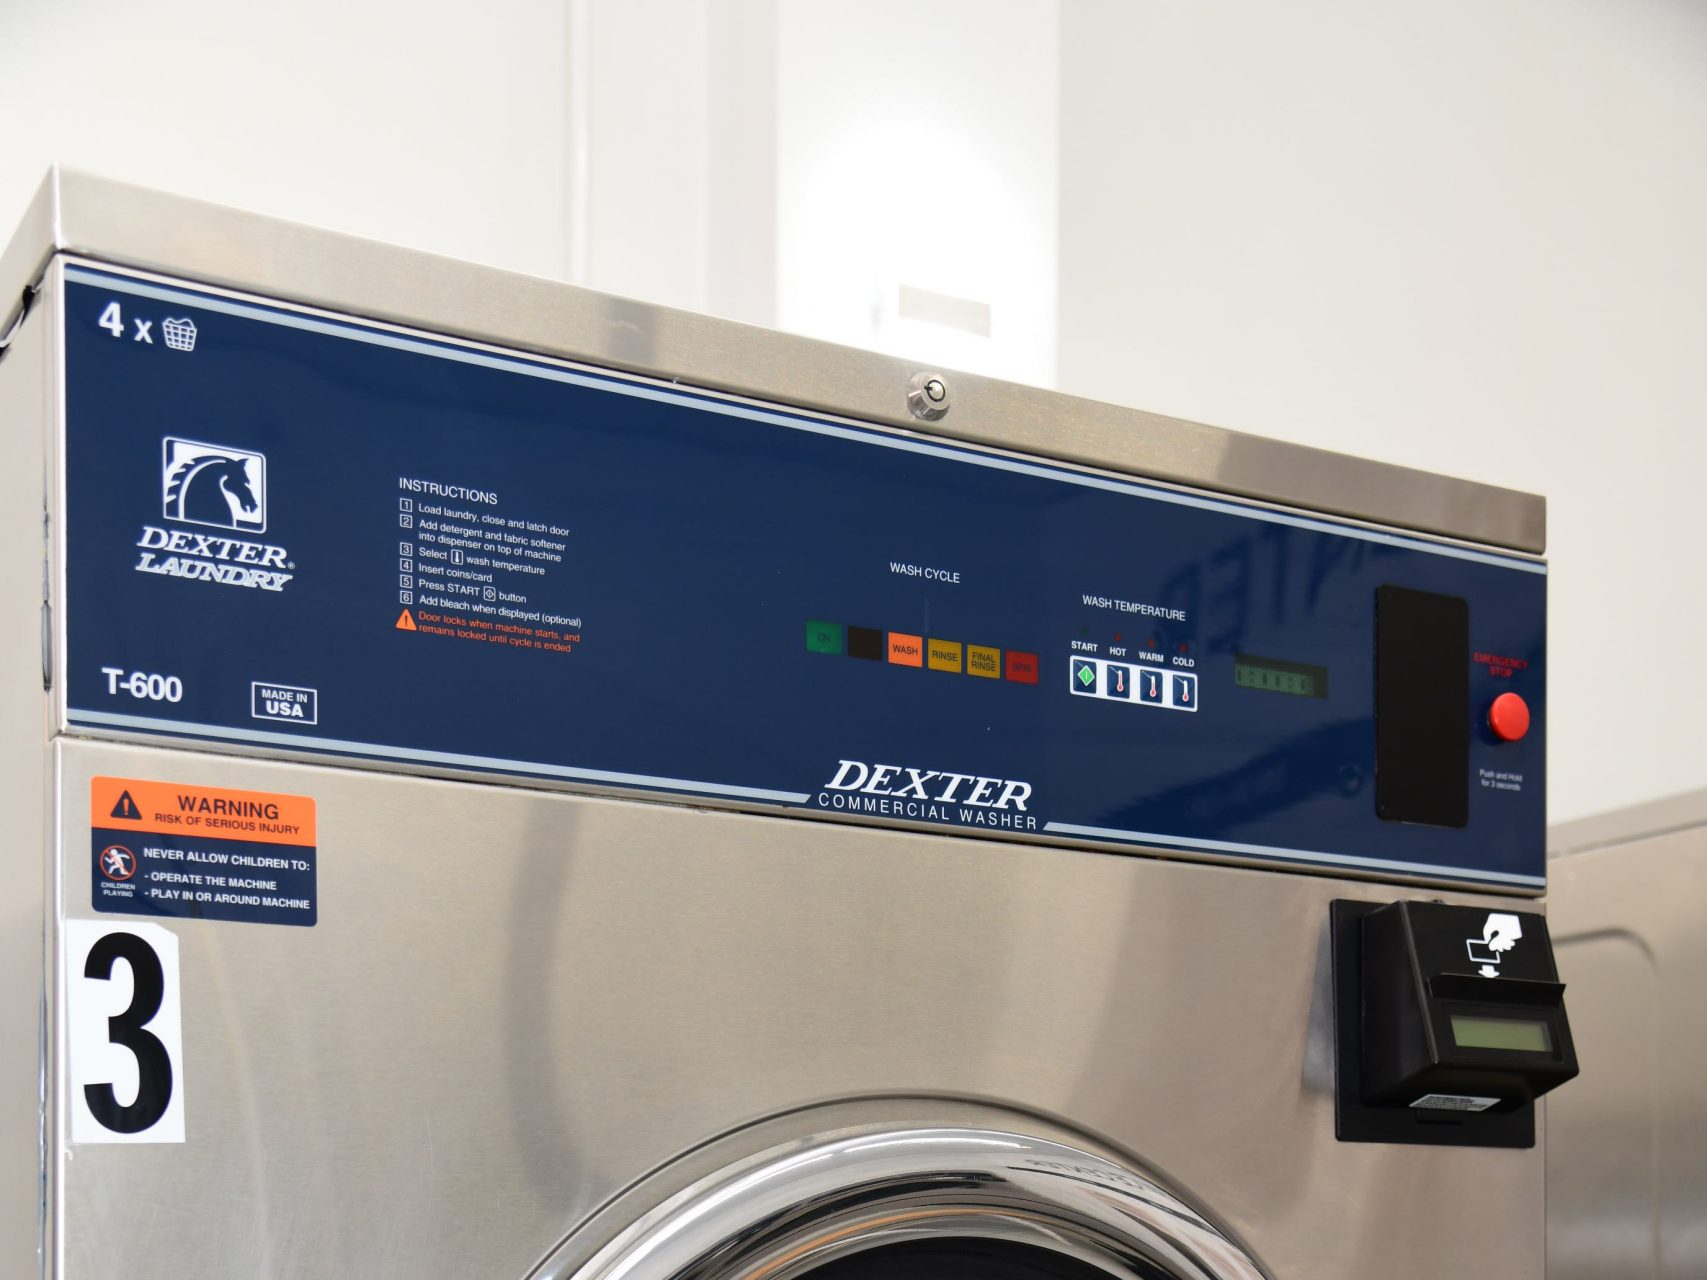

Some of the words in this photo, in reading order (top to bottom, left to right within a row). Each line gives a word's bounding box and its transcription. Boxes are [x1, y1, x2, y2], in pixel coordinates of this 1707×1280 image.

[98, 302, 124, 337] 4
[400, 477, 498, 505] INSTRUCTIONS
[419, 503, 441, 514] Load
[482, 515, 505, 525] close
[508, 520, 524, 529] and
[527, 522, 547, 532] latch
[550, 526, 569, 536] door
[420, 520, 437, 530] Add
[440, 523, 482, 538] detergent
[485, 531, 501, 540] and
[504, 534, 528, 545] fabric
[531, 538, 566, 551] softener
[419, 532, 435, 541] into
[438, 535, 481, 550] dispenser
[484, 543, 495, 551] on
[498, 545, 511, 555] top
[514, 547, 523, 556] of
[525, 549, 562, 562] machine
[135, 552, 293, 592] LAUNDRY
[419, 548, 447, 559] Select
[467, 555, 489, 566] wash
[492, 559, 545, 575] temperature
[419, 563, 444, 575] Insert
[447, 568, 492, 582] coins/card
[890, 562, 922, 577] WASH
[925, 568, 960, 583] CYCLE
[419, 579, 444, 591] Press
[448, 583, 480, 596] START
[499, 591, 527, 603] button
[420, 595, 438, 606] Add
[440, 599, 469, 610] bleach
[472, 604, 496, 615] when
[498, 607, 539, 622] displayed
[542, 613, 582, 629] (optional)
[1082, 595, 1112, 609] WASH
[1114, 600, 1186, 622] TEMPERATURE
[419, 611, 440, 622] Door
[443, 615, 467, 626] locks
[469, 619, 493, 630] when
[496, 623, 532, 635] machine
[564, 632, 580, 642] and
[419, 625, 455, 636] remains
[457, 629, 486, 641] locked
[489, 634, 507, 643] until
[509, 638, 532, 648] cycle
[535, 640, 542, 648] is
[544, 643, 571, 652] ended
[1071, 640, 1097, 652] START
[892, 644, 918, 656] WASH
[932, 651, 957, 661] RINSE
[972, 652, 995, 663] FINAL
[1110, 647, 1126, 656] HOT
[1139, 651, 1164, 662] WARM
[1474, 652, 1528, 669] EMERGENCY
[971, 661, 996, 672] RINSE
[1173, 657, 1194, 667] COLD
[1489, 666, 1512, 677] STOP
[102, 667, 183, 703] T-600
[262, 689, 294, 701] MADE
[296, 694, 307, 703] IN
[266, 701, 304, 717] USA
[824, 760, 1032, 812] DEXTER
[178, 795, 279, 820] WARNING
[818, 792, 950, 820] COMMERCIAL
[959, 809, 1036, 830] WASHER
[155, 813, 182, 824] RISK
[186, 816, 201, 826] OF
[205, 818, 256, 831] SERIOUS
[259, 823, 299, 835] INJURY
[144, 848, 184, 860] NEVER
[187, 852, 228, 864] ALLOW
[231, 855, 289, 868] CHILDREN
[291, 860, 310, 871] TO:
[100, 881, 136, 890] CHILDREN
[151, 873, 202, 884] OPERATE
[205, 876, 225, 886] THE
[229, 878, 277, 890] MACHINE
[103, 889, 133, 898] PLAYING
[151, 889, 179, 900] PLAY
[183, 892, 193, 901] IN
[196, 892, 212, 902] OR
[214, 894, 260, 905] AROUND
[262, 898, 310, 909] MACHINE
[84, 931, 173, 1134] 3
